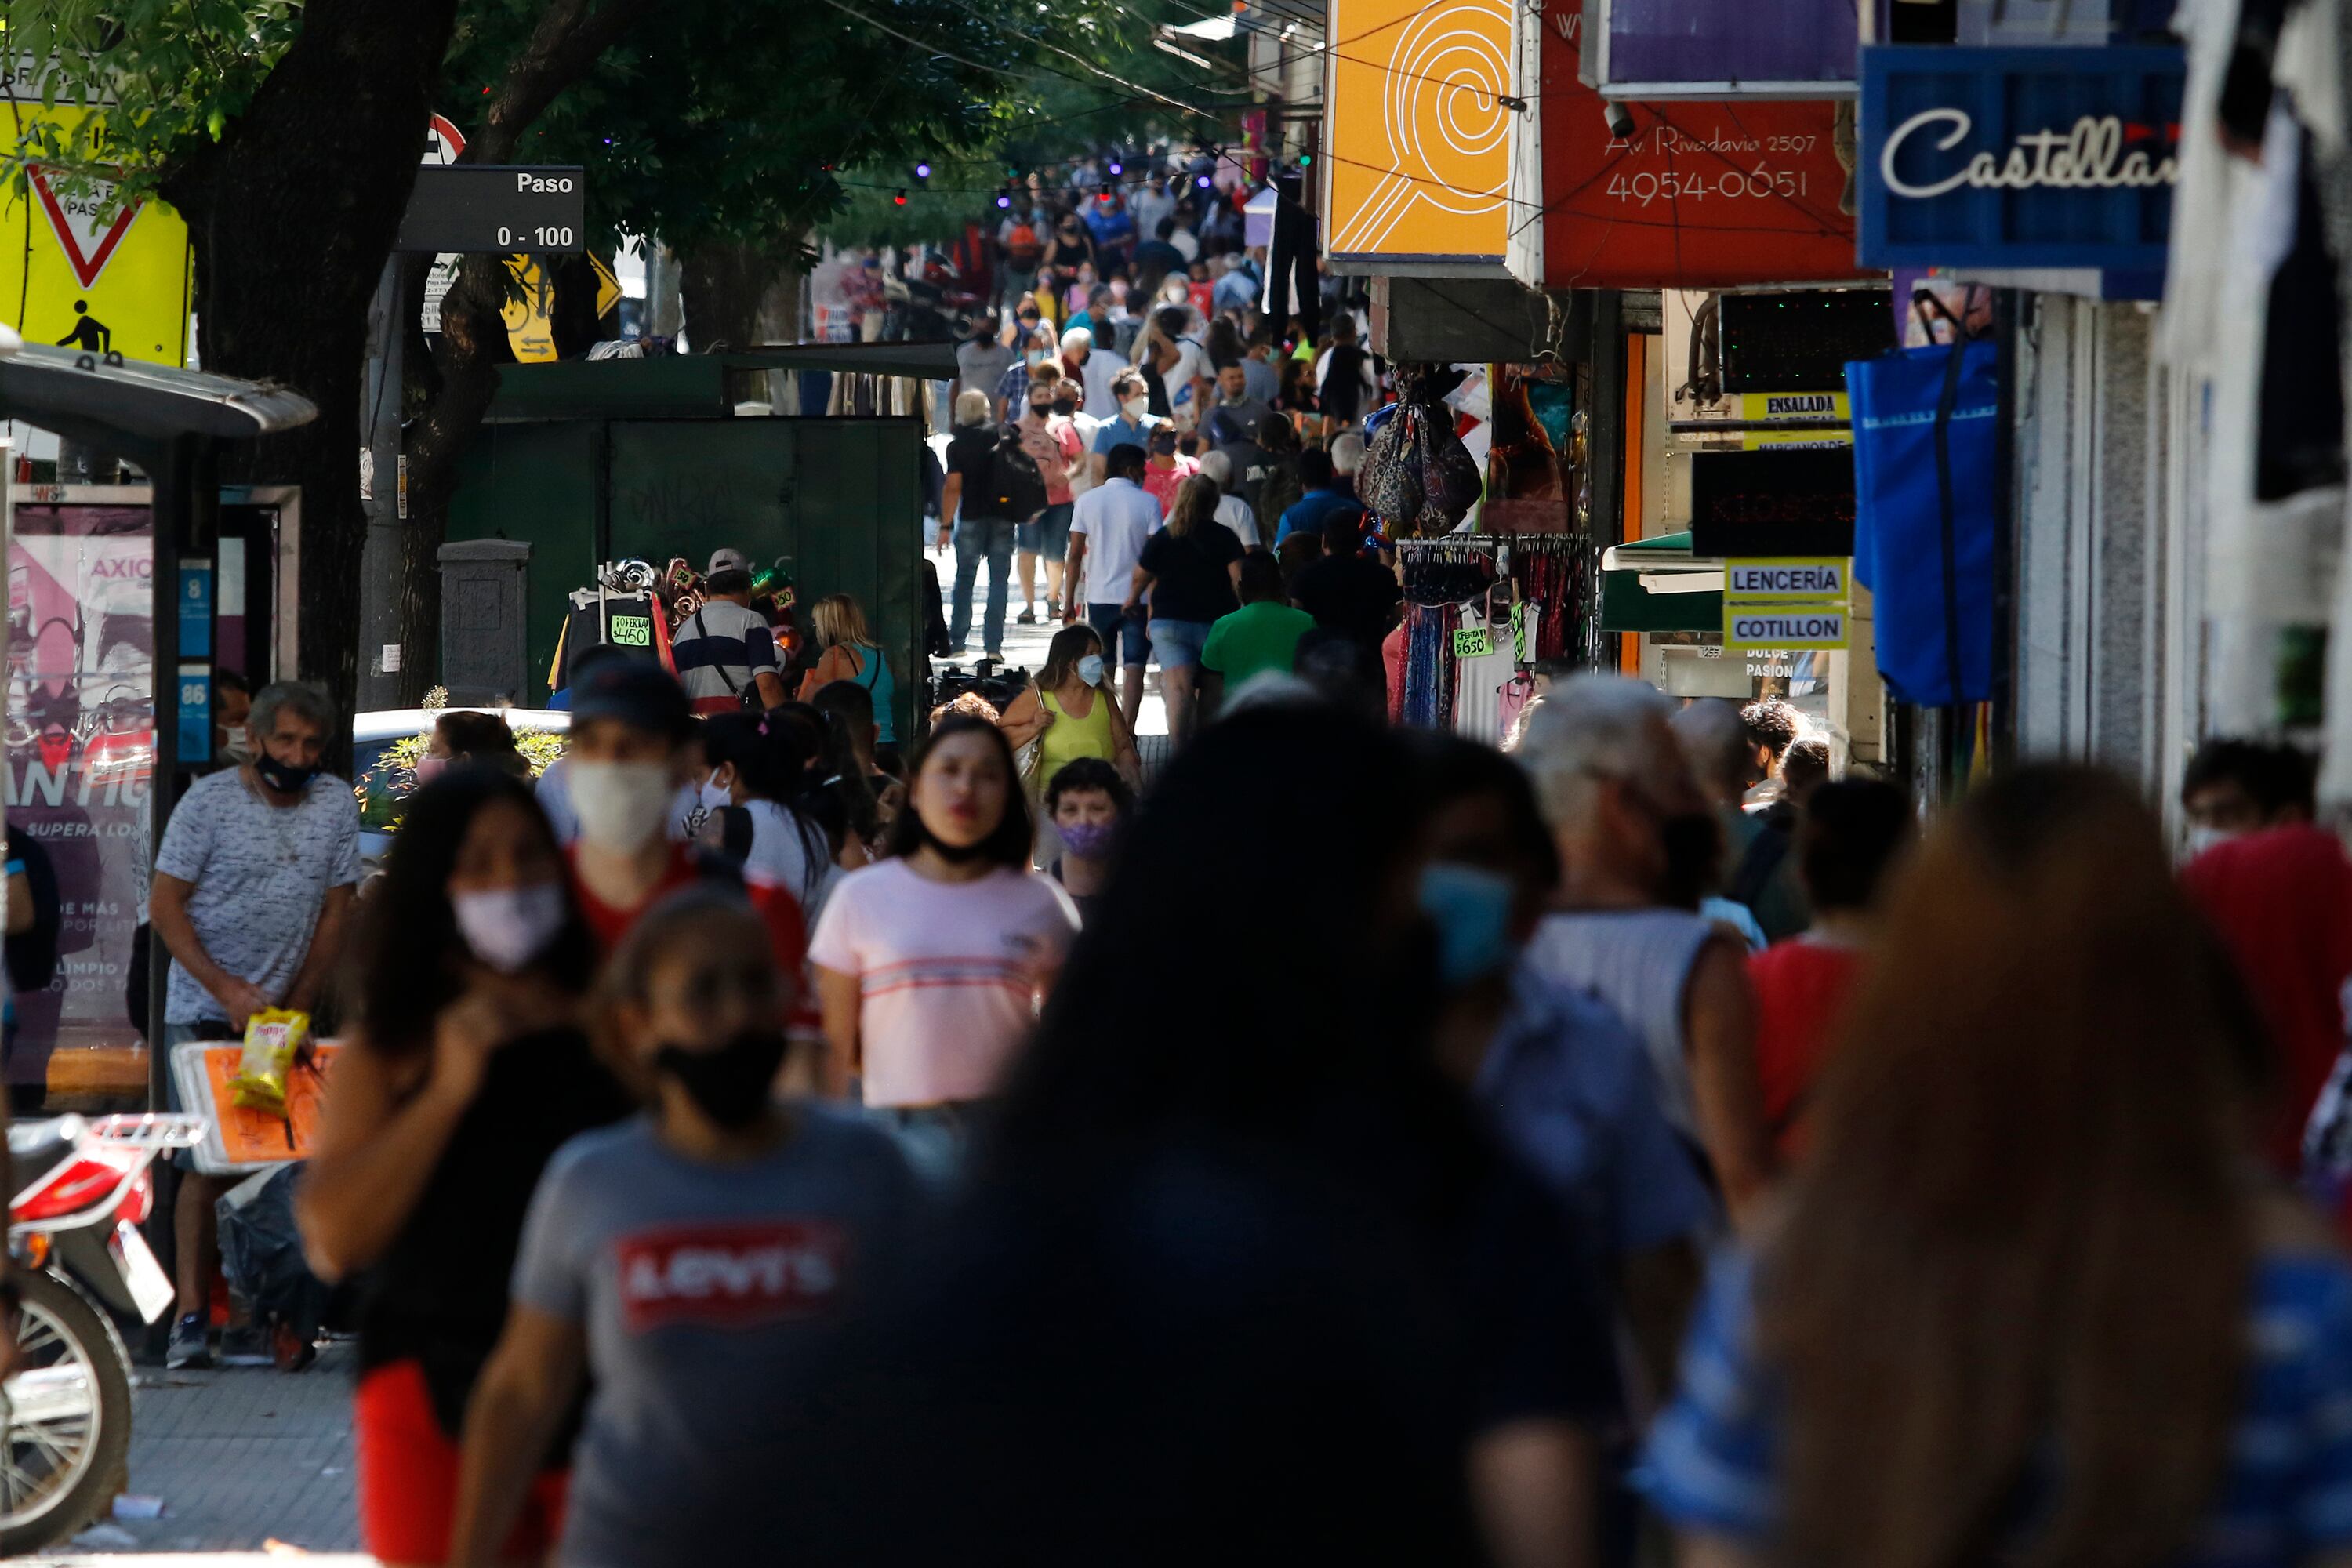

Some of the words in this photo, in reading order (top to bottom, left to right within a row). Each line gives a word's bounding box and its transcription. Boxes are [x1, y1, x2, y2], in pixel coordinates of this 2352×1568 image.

[1656, 126, 1760, 155] Rivadavia
[1767, 136, 1816, 155] 2597
[517, 172, 573, 193] Paso
[1607, 161, 1806, 207] 4954-0651
[68, 202, 99, 216] PAS
[497, 227, 511, 246] 0
[534, 227, 573, 246] 100
[1768, 396, 1835, 414] ENSALADA
[1734, 566, 1838, 590] LENCERÍA
[188, 579, 201, 599] 8
[614, 628, 647, 644] $450
[1737, 619, 1839, 637] COTILLON
[1456, 640, 1485, 654] $650
[1746, 664, 1794, 678] PASION
[181, 684, 206, 705] 86
[26, 822, 100, 837] SUPERA
[56, 963, 118, 975] LIMPIO
